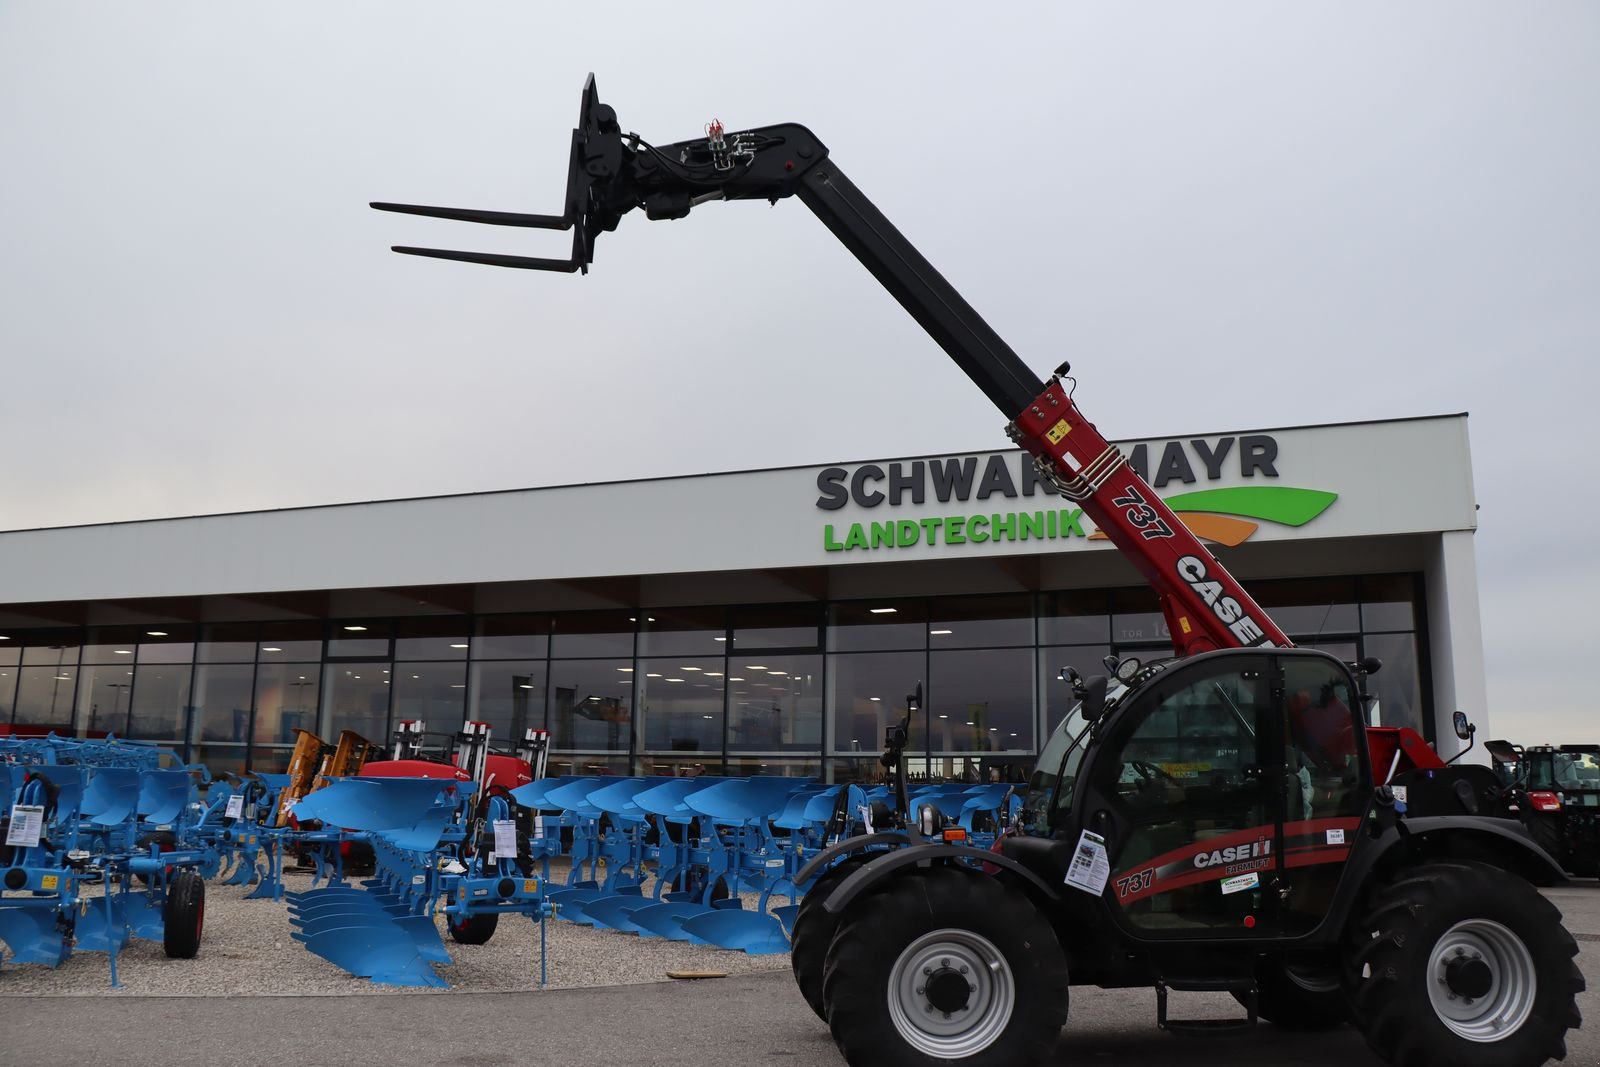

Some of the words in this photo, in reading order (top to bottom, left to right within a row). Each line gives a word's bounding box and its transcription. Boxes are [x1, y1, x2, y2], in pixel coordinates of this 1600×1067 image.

[1112, 485, 1176, 540] 737
[824, 508, 1086, 552] LANDTECHNIK
[1176, 555, 1265, 646] CASE
[1121, 629, 1143, 638] TOR
[1194, 844, 1250, 868] CASE
[1226, 858, 1270, 875] FARMLIFT
[1117, 867, 1154, 897] 737
